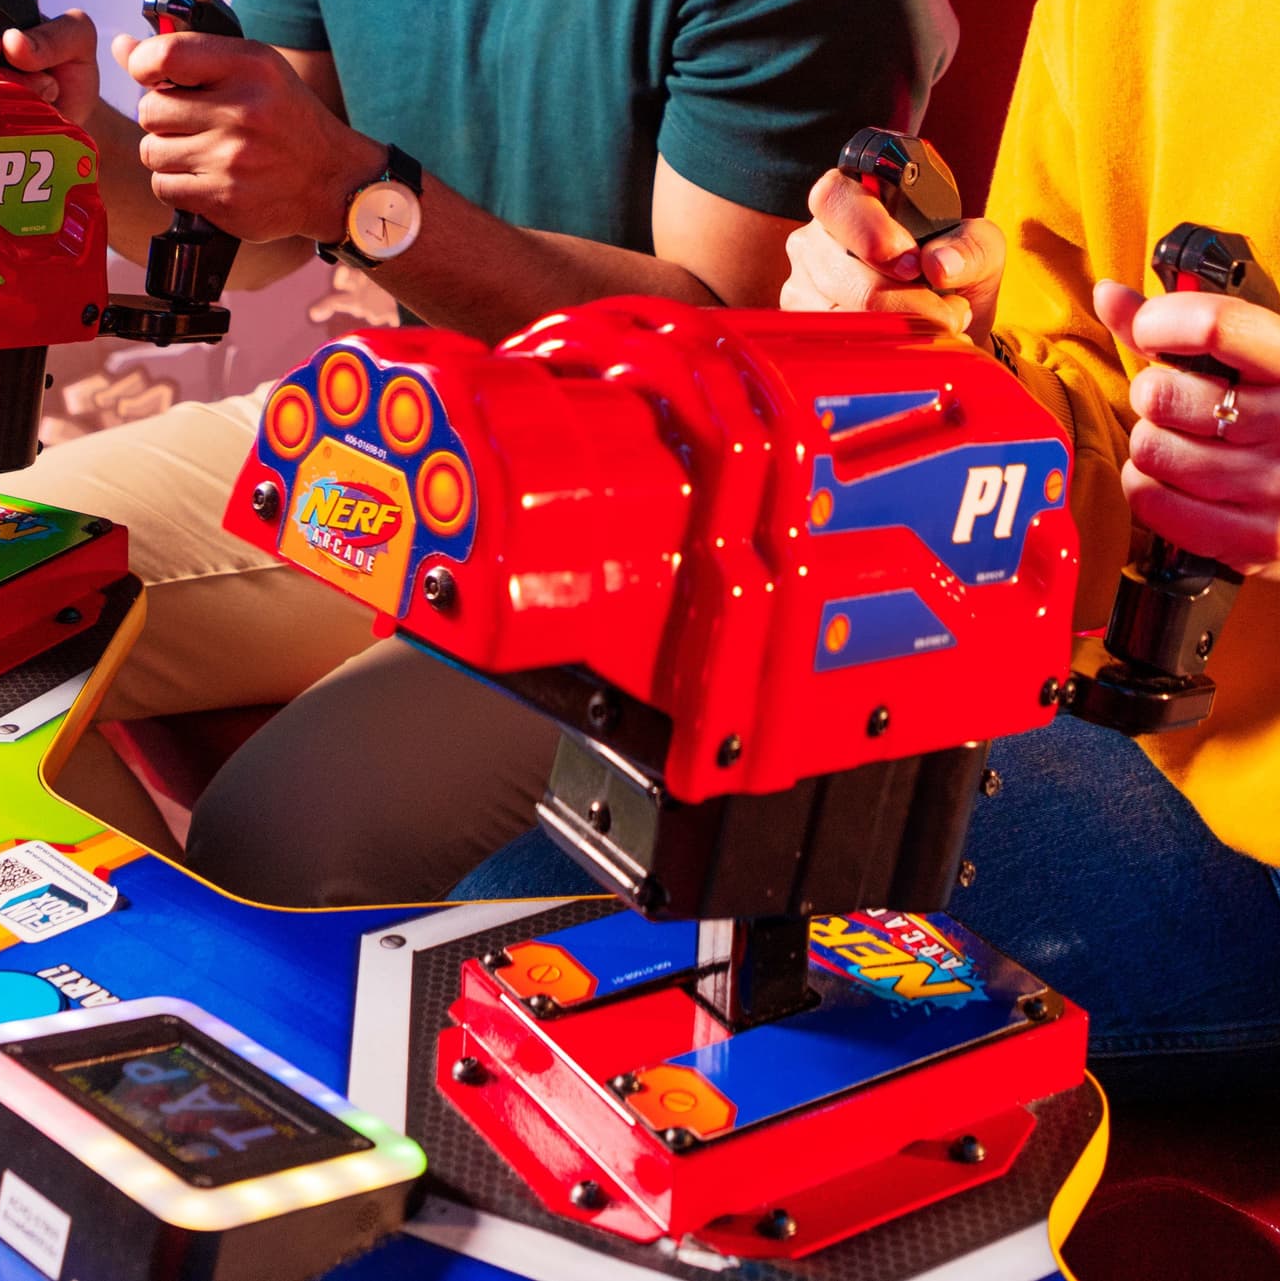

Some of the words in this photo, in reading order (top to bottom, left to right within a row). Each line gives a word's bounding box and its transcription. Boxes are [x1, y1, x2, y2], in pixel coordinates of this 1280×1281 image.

[300, 486, 402, 536] NERF
[952, 463, 1027, 544] P1
[311, 527, 376, 572] ARCADE
[35, 891, 87, 926] BOX
[865, 908, 963, 969] ARCA
[810, 915, 972, 1000] NER
[122, 1061, 277, 1152] TAP
